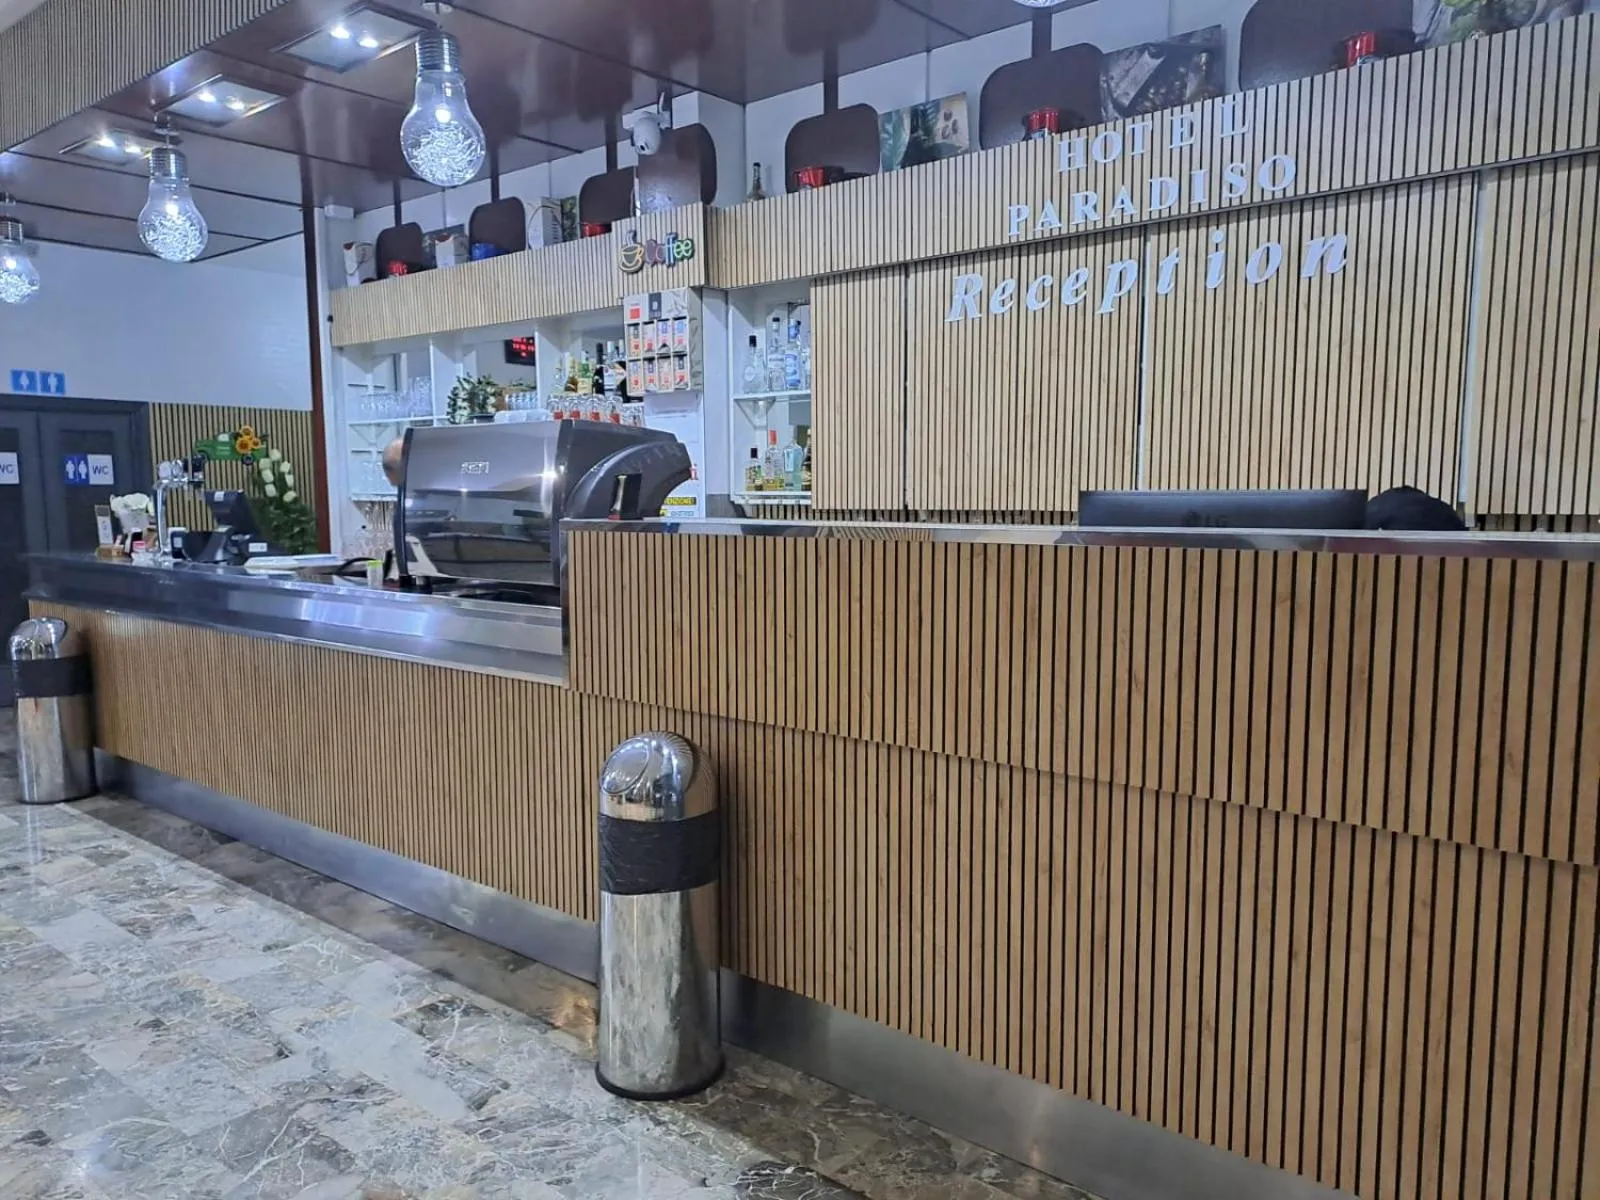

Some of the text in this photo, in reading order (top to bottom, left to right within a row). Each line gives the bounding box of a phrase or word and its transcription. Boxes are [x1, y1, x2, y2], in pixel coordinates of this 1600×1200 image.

[1058, 102, 1250, 173] HOTEL
[1008, 154, 1297, 237] PARADISO
[945, 229, 1348, 322] Reception
[92, 465, 109, 475] WC
